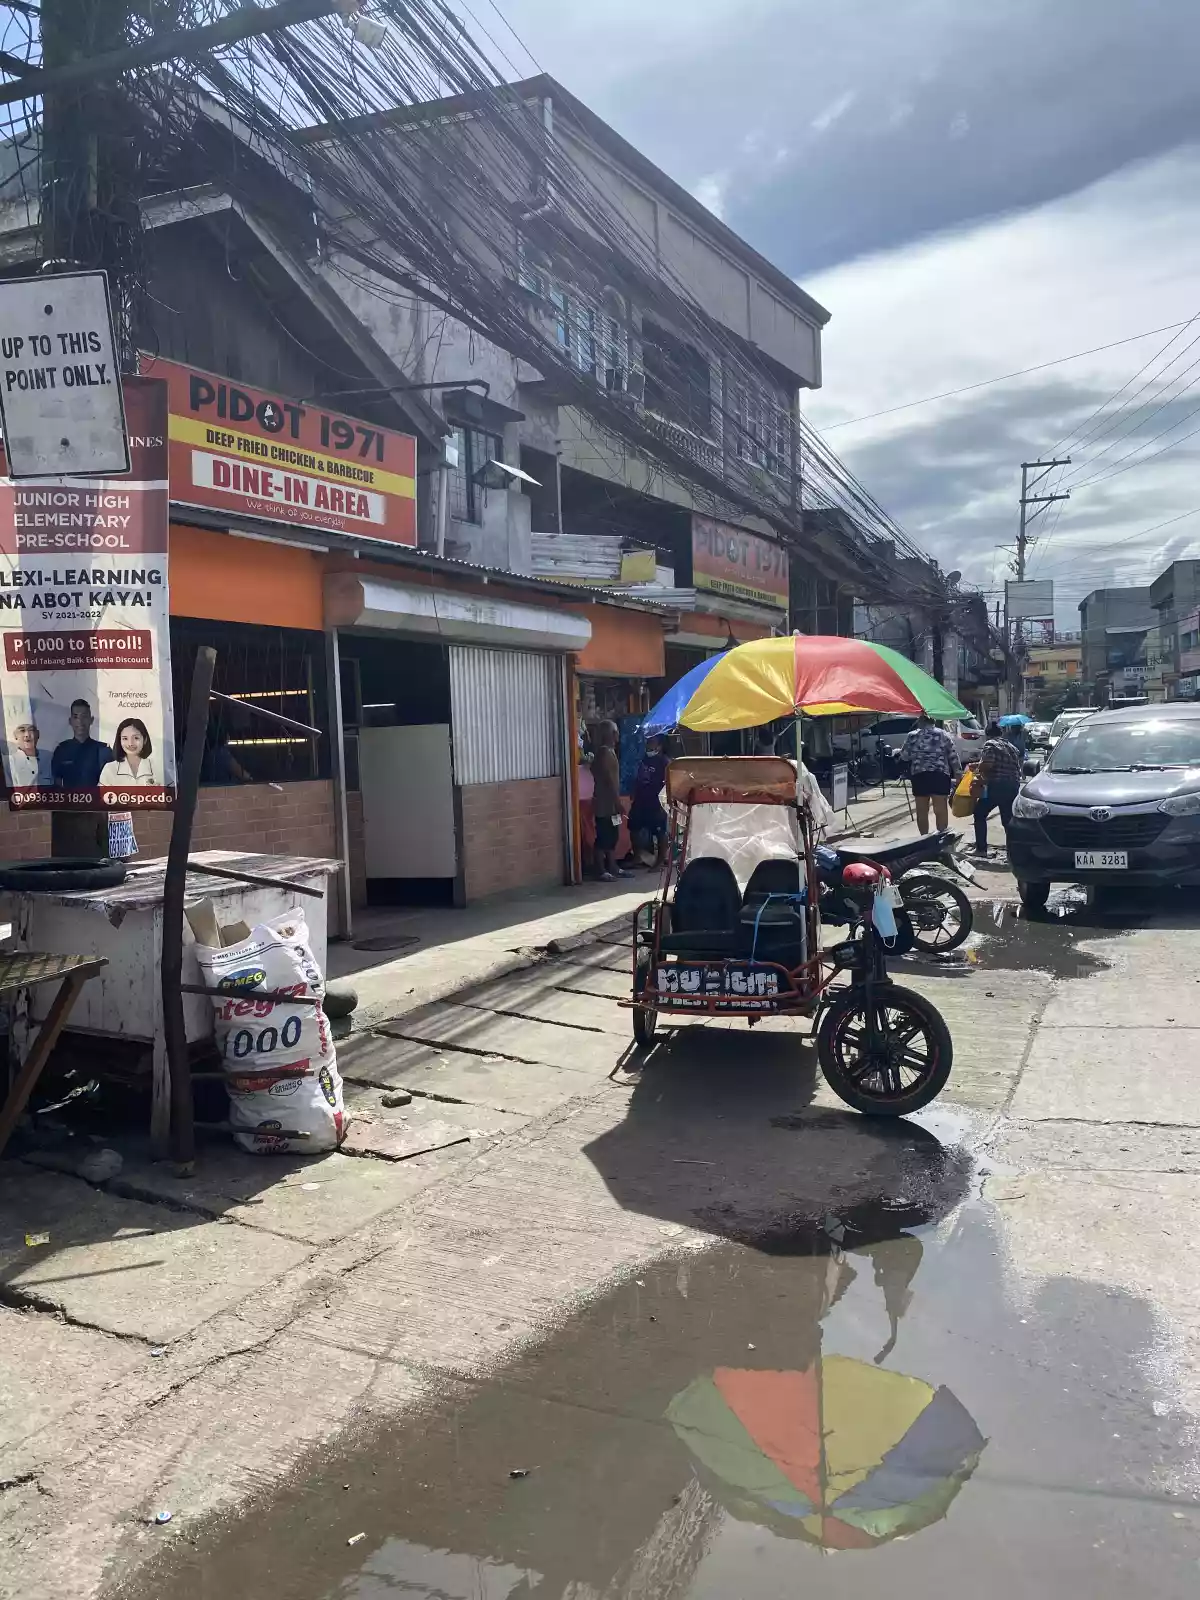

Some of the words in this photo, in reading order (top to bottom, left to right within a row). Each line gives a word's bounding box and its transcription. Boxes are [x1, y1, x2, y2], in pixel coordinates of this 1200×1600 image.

[1, 336, 24, 359] UP
[29, 334, 52, 356] TO
[57, 331, 102, 355] THIS
[6, 367, 57, 391] POINT
[63, 363, 112, 387] ONLY.
[189, 374, 307, 440] PIDOT
[320, 414, 386, 463] 1971
[206, 428, 235, 449] DEEP
[236, 436, 269, 458] FRIED
[270, 446, 316, 469] CHICKEN
[317, 460, 325, 472] &
[326, 461, 375, 484] BARBECUE
[212, 459, 310, 507] DINE-IN
[314, 485, 371, 519] AREA
[13, 492, 80, 507] JUNIOR
[85, 495, 130, 509] HIGH
[246, 498, 262, 510] We
[265, 503, 287, 517] think
[287, 508, 298, 517] of
[299, 511, 313, 521] you
[13, 512, 131, 529] ELEMENTARY
[15, 533, 130, 548] PRE-SCHOOL
[31, 591, 83, 609] ABOT
[89, 591, 152, 607] KAYA!
[42, 611, 53, 620] SY
[56, 610, 102, 619] 2021-2022
[13, 638, 65, 654] P1,000
[68, 637, 85, 651] to
[89, 635, 143, 650] Enroll!
[30, 657, 38, 665] of
[39, 657, 66, 666] Tabang
[86, 656, 114, 664] Eskwela
[115, 656, 150, 664] Discount
[108, 691, 148, 699] Transferees
[67, 793, 93, 803] 1820
[1076, 855, 1095, 866] KAA
[1101, 855, 1127, 866] 3281
